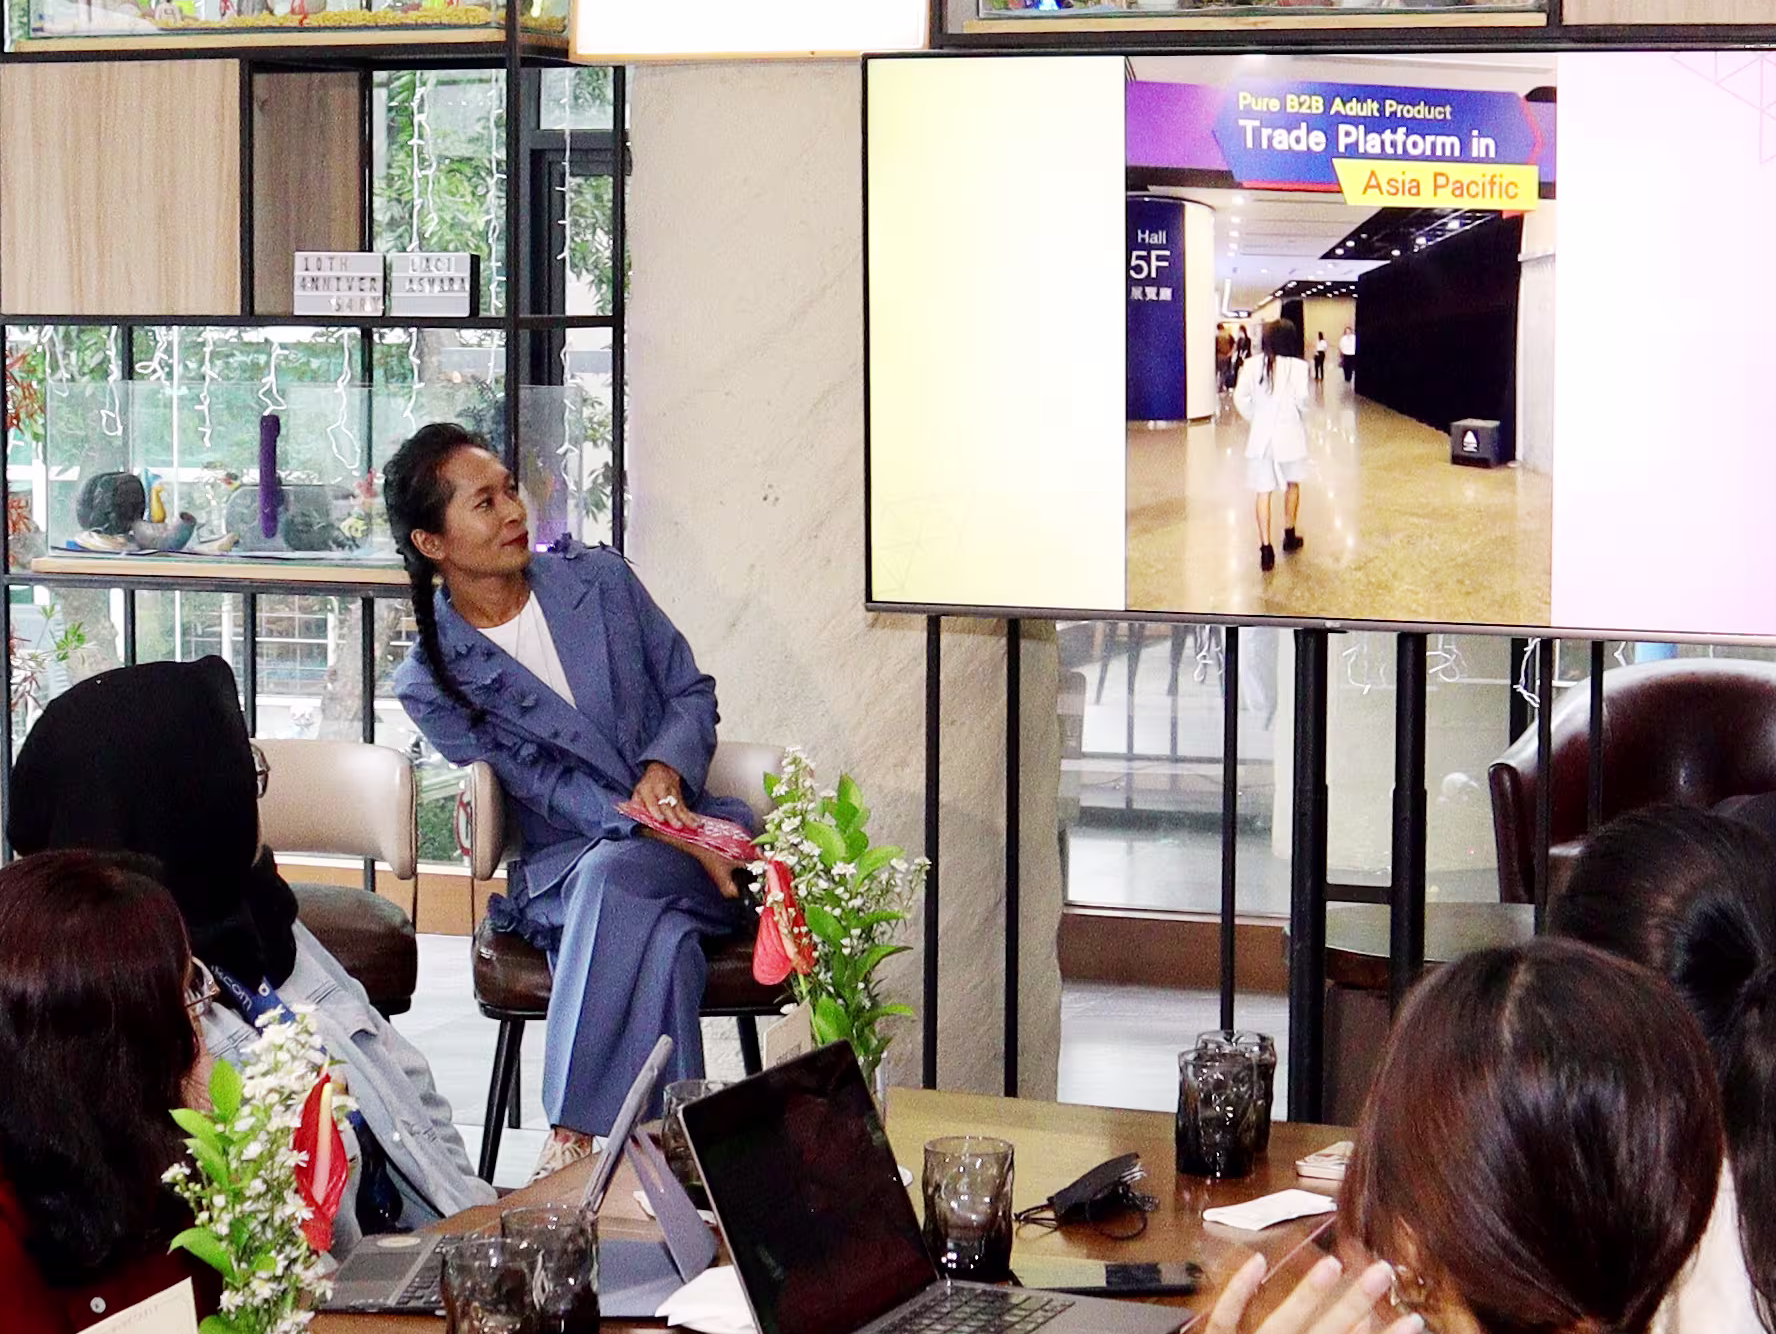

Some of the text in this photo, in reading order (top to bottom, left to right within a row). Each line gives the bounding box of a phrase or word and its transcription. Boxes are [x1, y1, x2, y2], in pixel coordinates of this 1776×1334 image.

[1238, 91, 1452, 120] Pure B2B Adult Product
[1238, 119, 1496, 158] Trade Platform in
[1362, 170, 1519, 200] Asia Pacific
[1137, 229, 1167, 244] Hall
[1129, 250, 1171, 279] 5F
